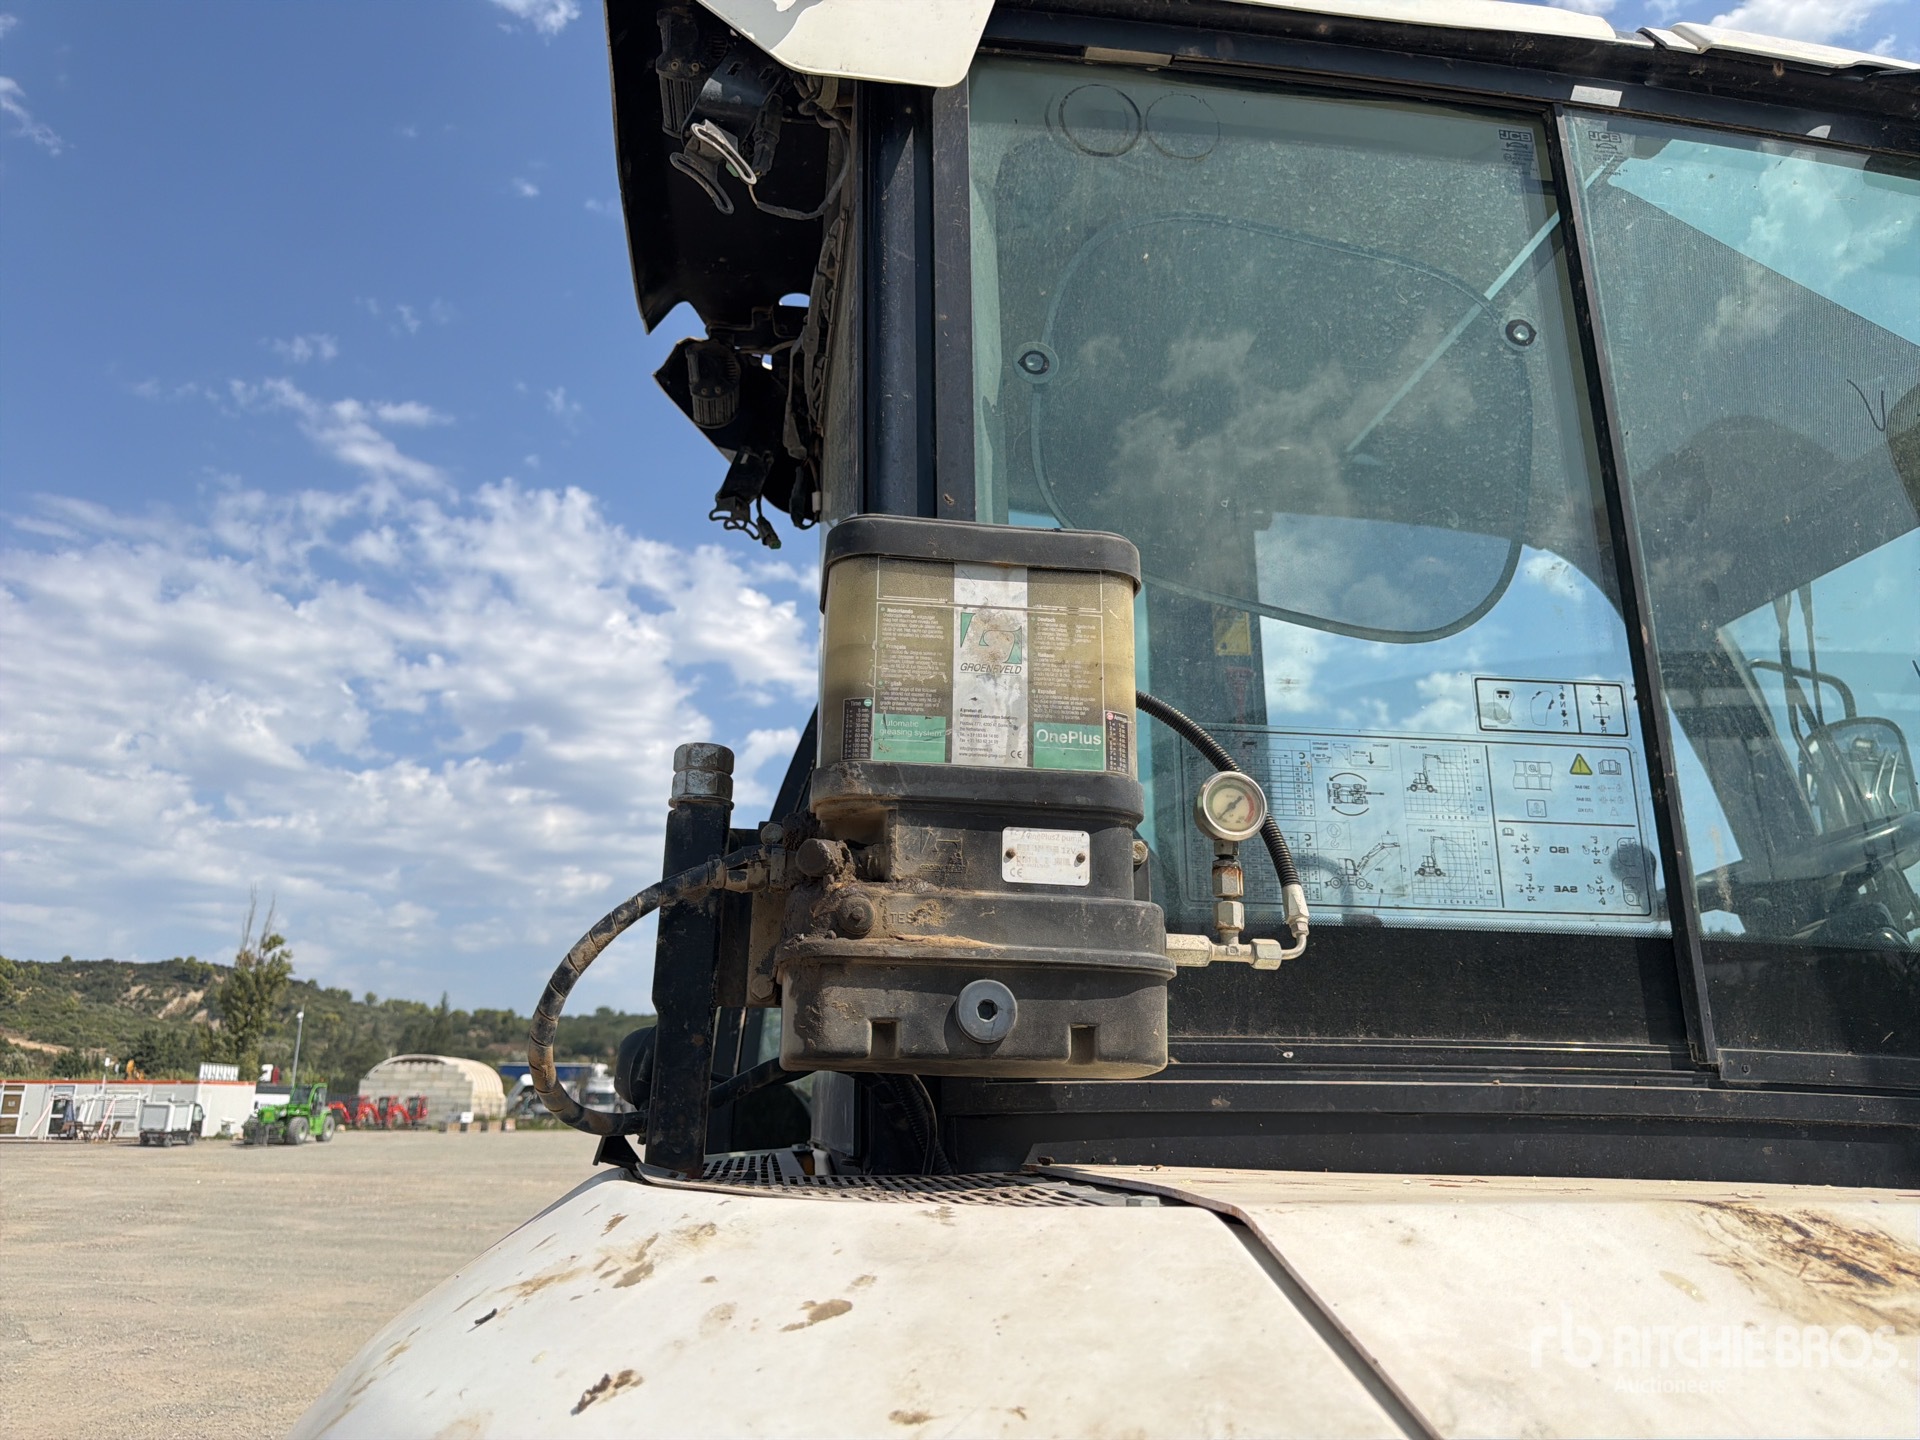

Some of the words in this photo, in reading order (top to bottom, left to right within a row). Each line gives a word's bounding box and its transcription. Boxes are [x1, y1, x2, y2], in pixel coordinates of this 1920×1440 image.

[1499, 130, 1532, 141] JCB
[1588, 132, 1621, 143] JCB
[960, 662, 1022, 674] GROENEVELD
[880, 728, 912, 737] greasing
[1036, 728, 1102, 745] OnePlus
